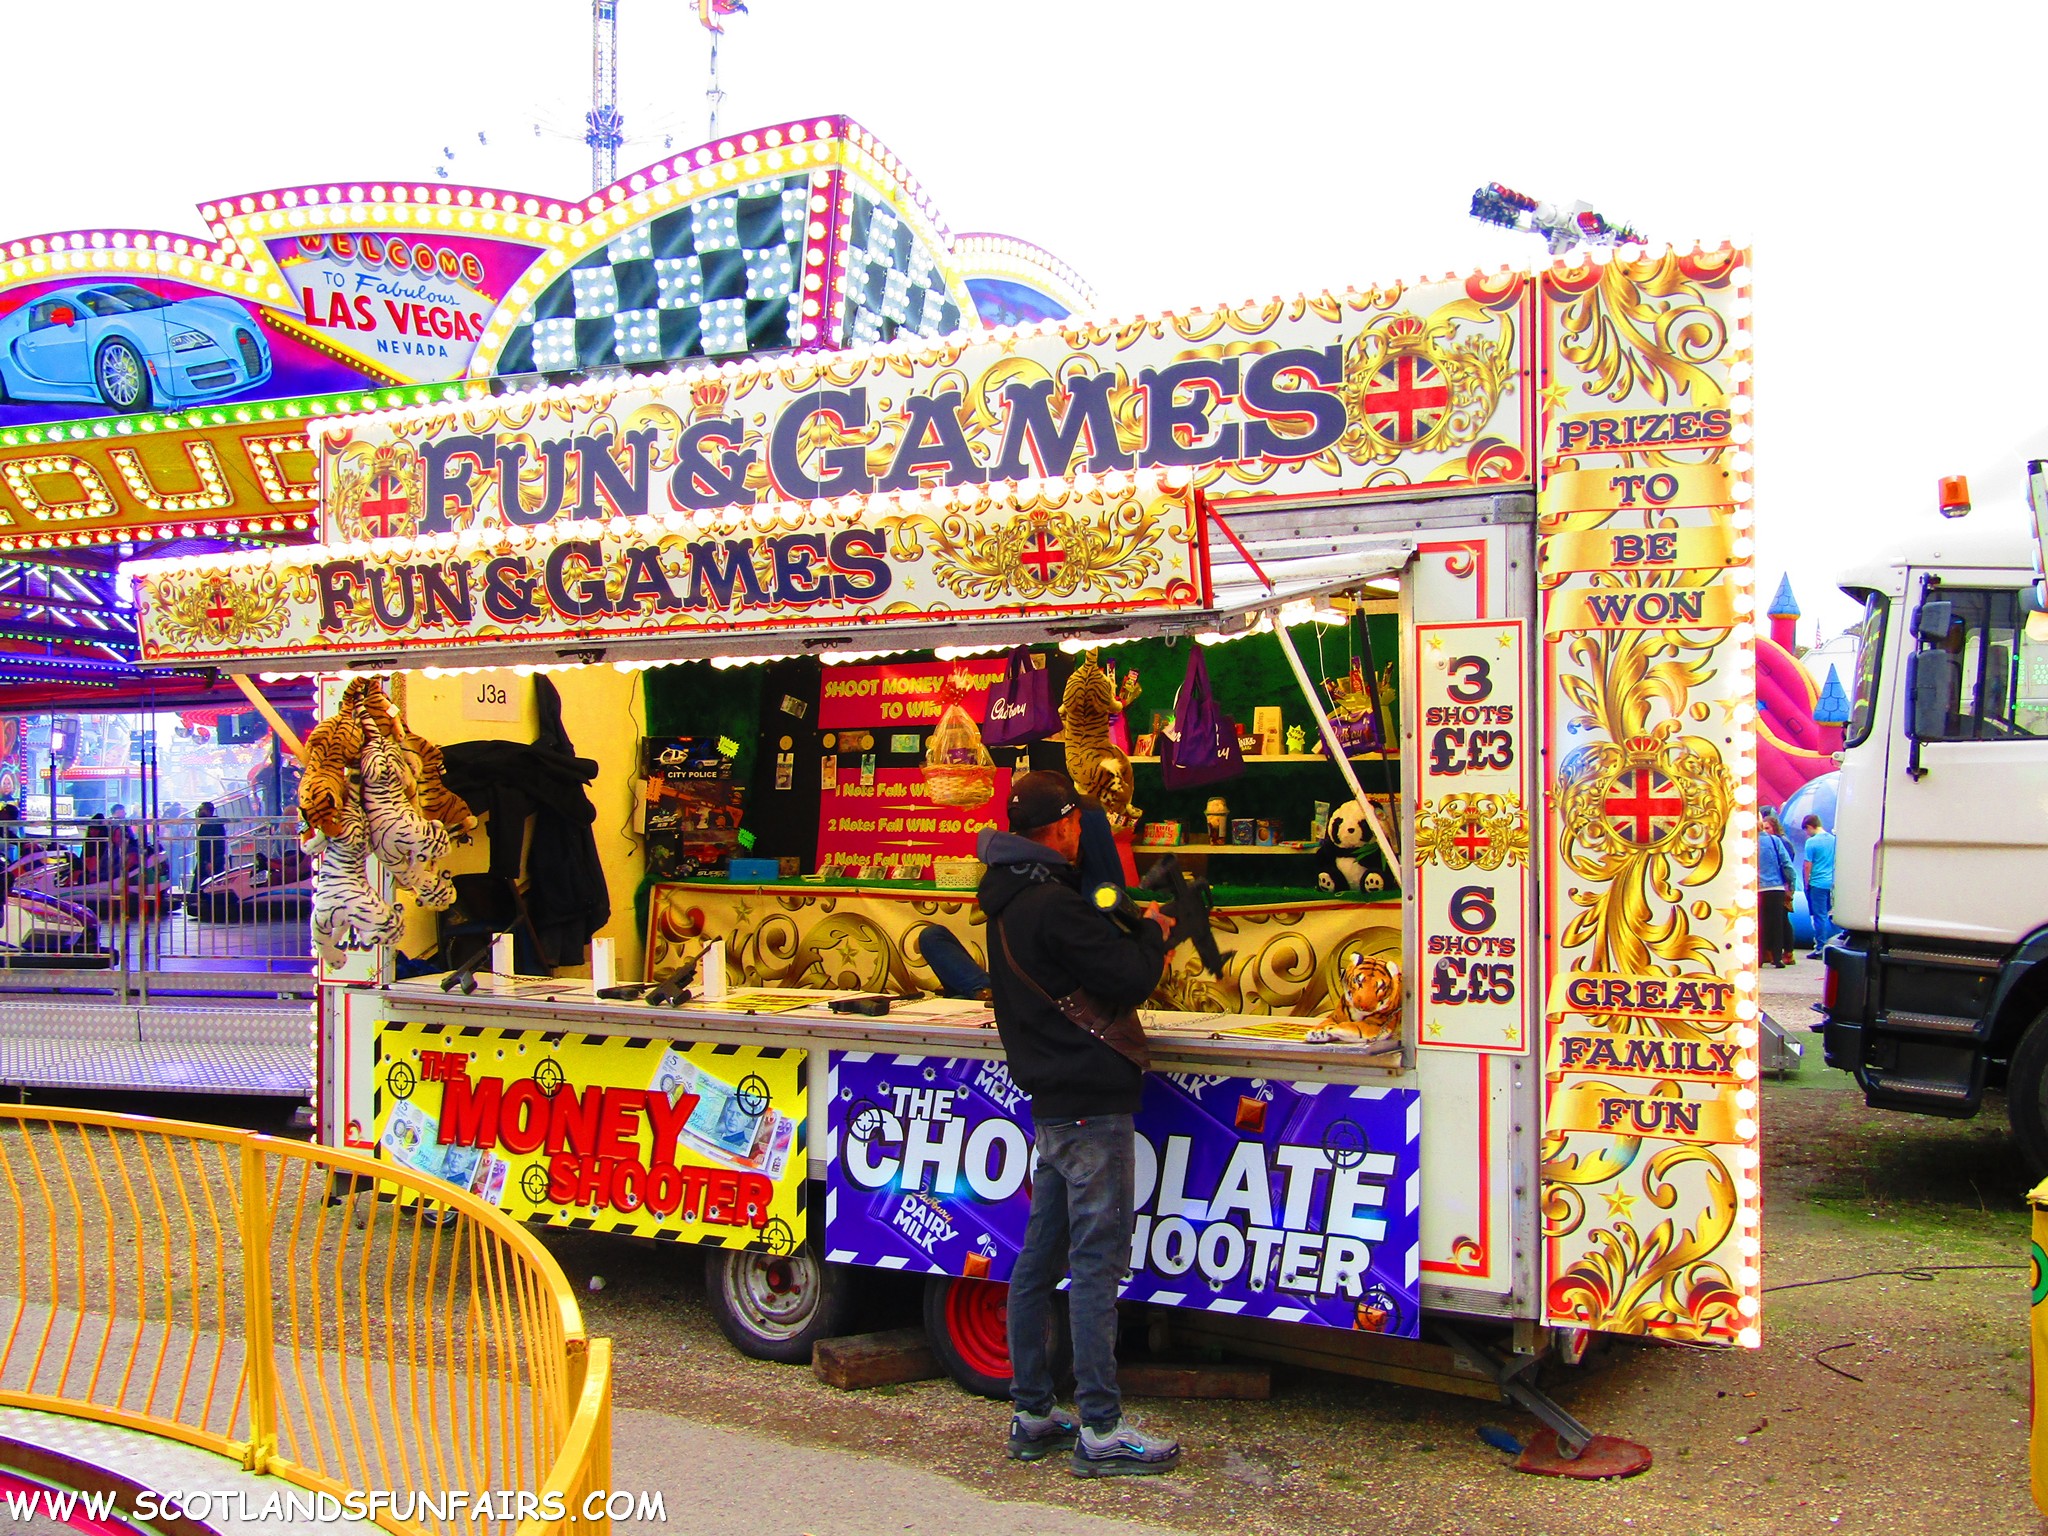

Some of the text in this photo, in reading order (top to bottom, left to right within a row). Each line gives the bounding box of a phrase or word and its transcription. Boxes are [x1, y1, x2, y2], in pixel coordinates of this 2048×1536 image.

[304, 236, 478, 277] WELCOME
[322, 271, 460, 306] TO Fabulous
[302, 287, 485, 342] LAS VEGAS
[376, 339, 448, 358] NEVADA
[415, 344, 1348, 535] FUN & GAMES
[1557, 409, 1732, 452] PRIZES
[1610, 473, 1679, 506] TO
[1611, 532, 1677, 566] BE
[313, 527, 893, 632] FUN & GAMES
[1585, 590, 1705, 627] WON
[477, 684, 506, 704] J3a
[824, 679, 879, 698] SHOOT
[882, 676, 944, 696] MONEY
[1447, 654, 1493, 704] 3
[880, 699, 942, 719] TO WIN
[1425, 704, 1513, 727] SHOTS
[843, 783, 874, 797] Note
[877, 783, 907, 797] Falls
[828, 818, 837, 832] 2
[839, 817, 875, 832] Notes
[878, 818, 904, 832] Fall
[906, 818, 936, 833] WIN
[938, 820, 961, 833] £10
[825, 853, 832, 865] 3
[834, 852, 870, 866] Notes
[873, 852, 899, 866] Fall
[901, 853, 932, 868] WIN
[1447, 885, 1497, 935] 6
[1427, 935, 1515, 958] SHOTS
[1566, 978, 1735, 1015] GREAT
[419, 1050, 469, 1082] THE
[1560, 1036, 1742, 1075] FAMILY
[437, 1076, 700, 1168] MONEY
[892, 1086, 955, 1121] THE
[1598, 1098, 1702, 1135] FUN
[547, 1153, 773, 1229] SHOOTER
[847, 1108, 1396, 1241] CHOLATE
[893, 1209, 941, 1255] MILK
[900, 1195, 959, 1243] DAIRY
